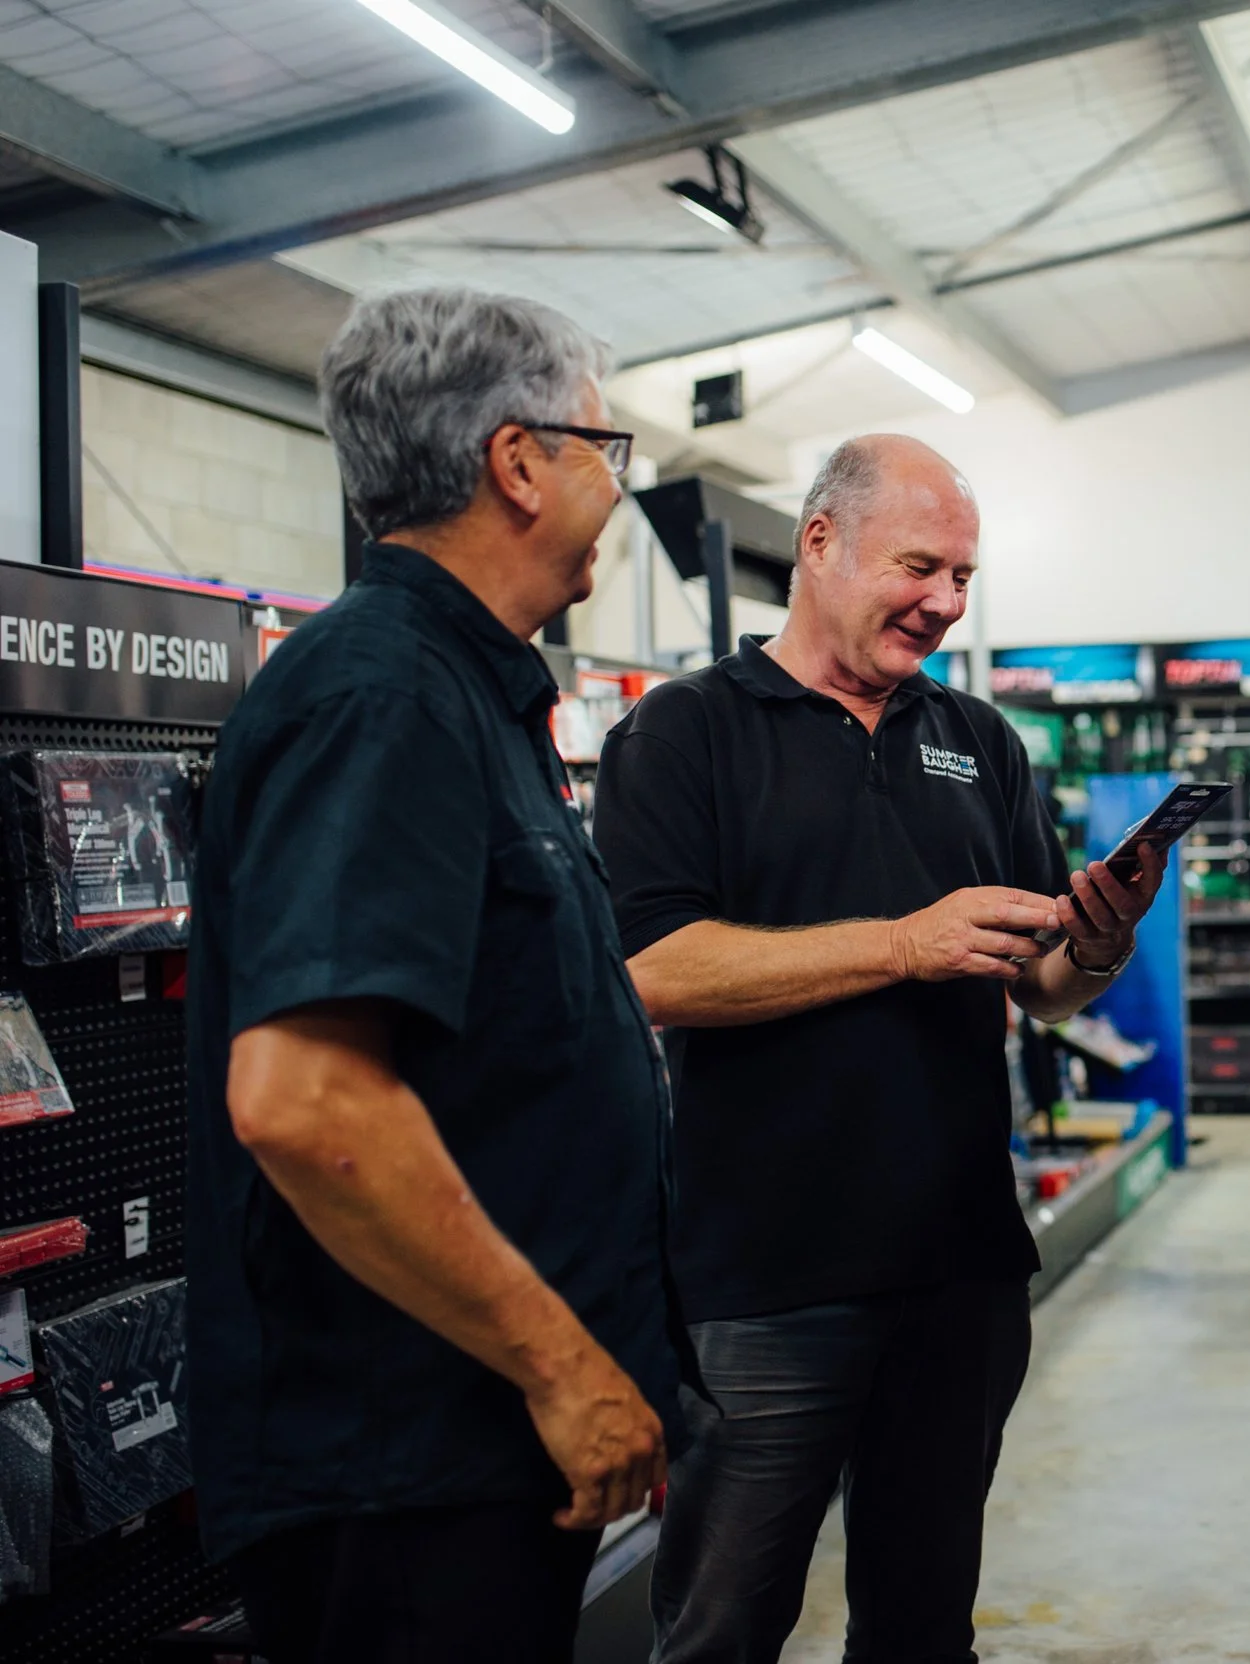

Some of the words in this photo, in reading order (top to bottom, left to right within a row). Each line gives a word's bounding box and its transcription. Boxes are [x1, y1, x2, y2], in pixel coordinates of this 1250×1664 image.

[86, 626, 124, 671] BY
[132, 632, 229, 683] DESIGN
[920, 743, 975, 767] SUMPTER
[922, 754, 979, 777] BAUGHEN
